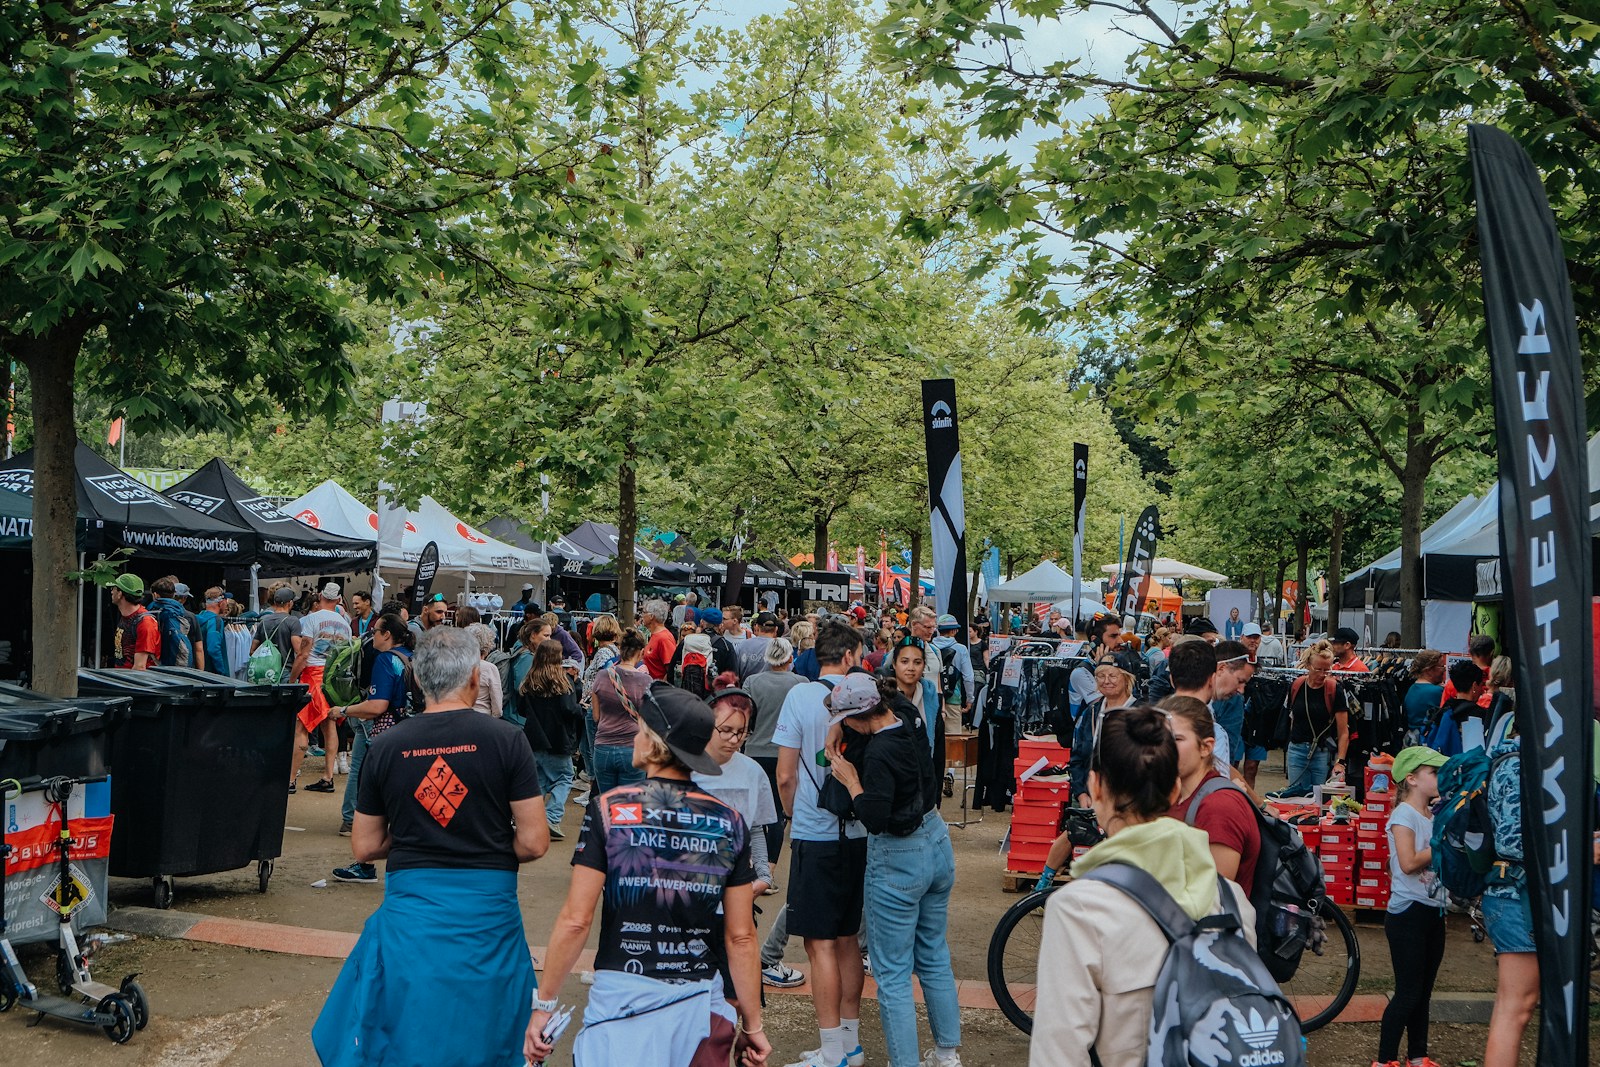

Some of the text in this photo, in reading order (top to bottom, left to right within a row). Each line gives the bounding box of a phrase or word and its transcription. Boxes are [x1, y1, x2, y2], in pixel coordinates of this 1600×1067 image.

[264, 540, 295, 557] Training
[337, 549, 372, 559] Community
[803, 583, 848, 601] TRI
[401, 744, 477, 758] TV BURGLENGENFELD
[630, 832, 718, 854] LAKE GARDA
[1240, 1050, 1285, 1066] adidas
